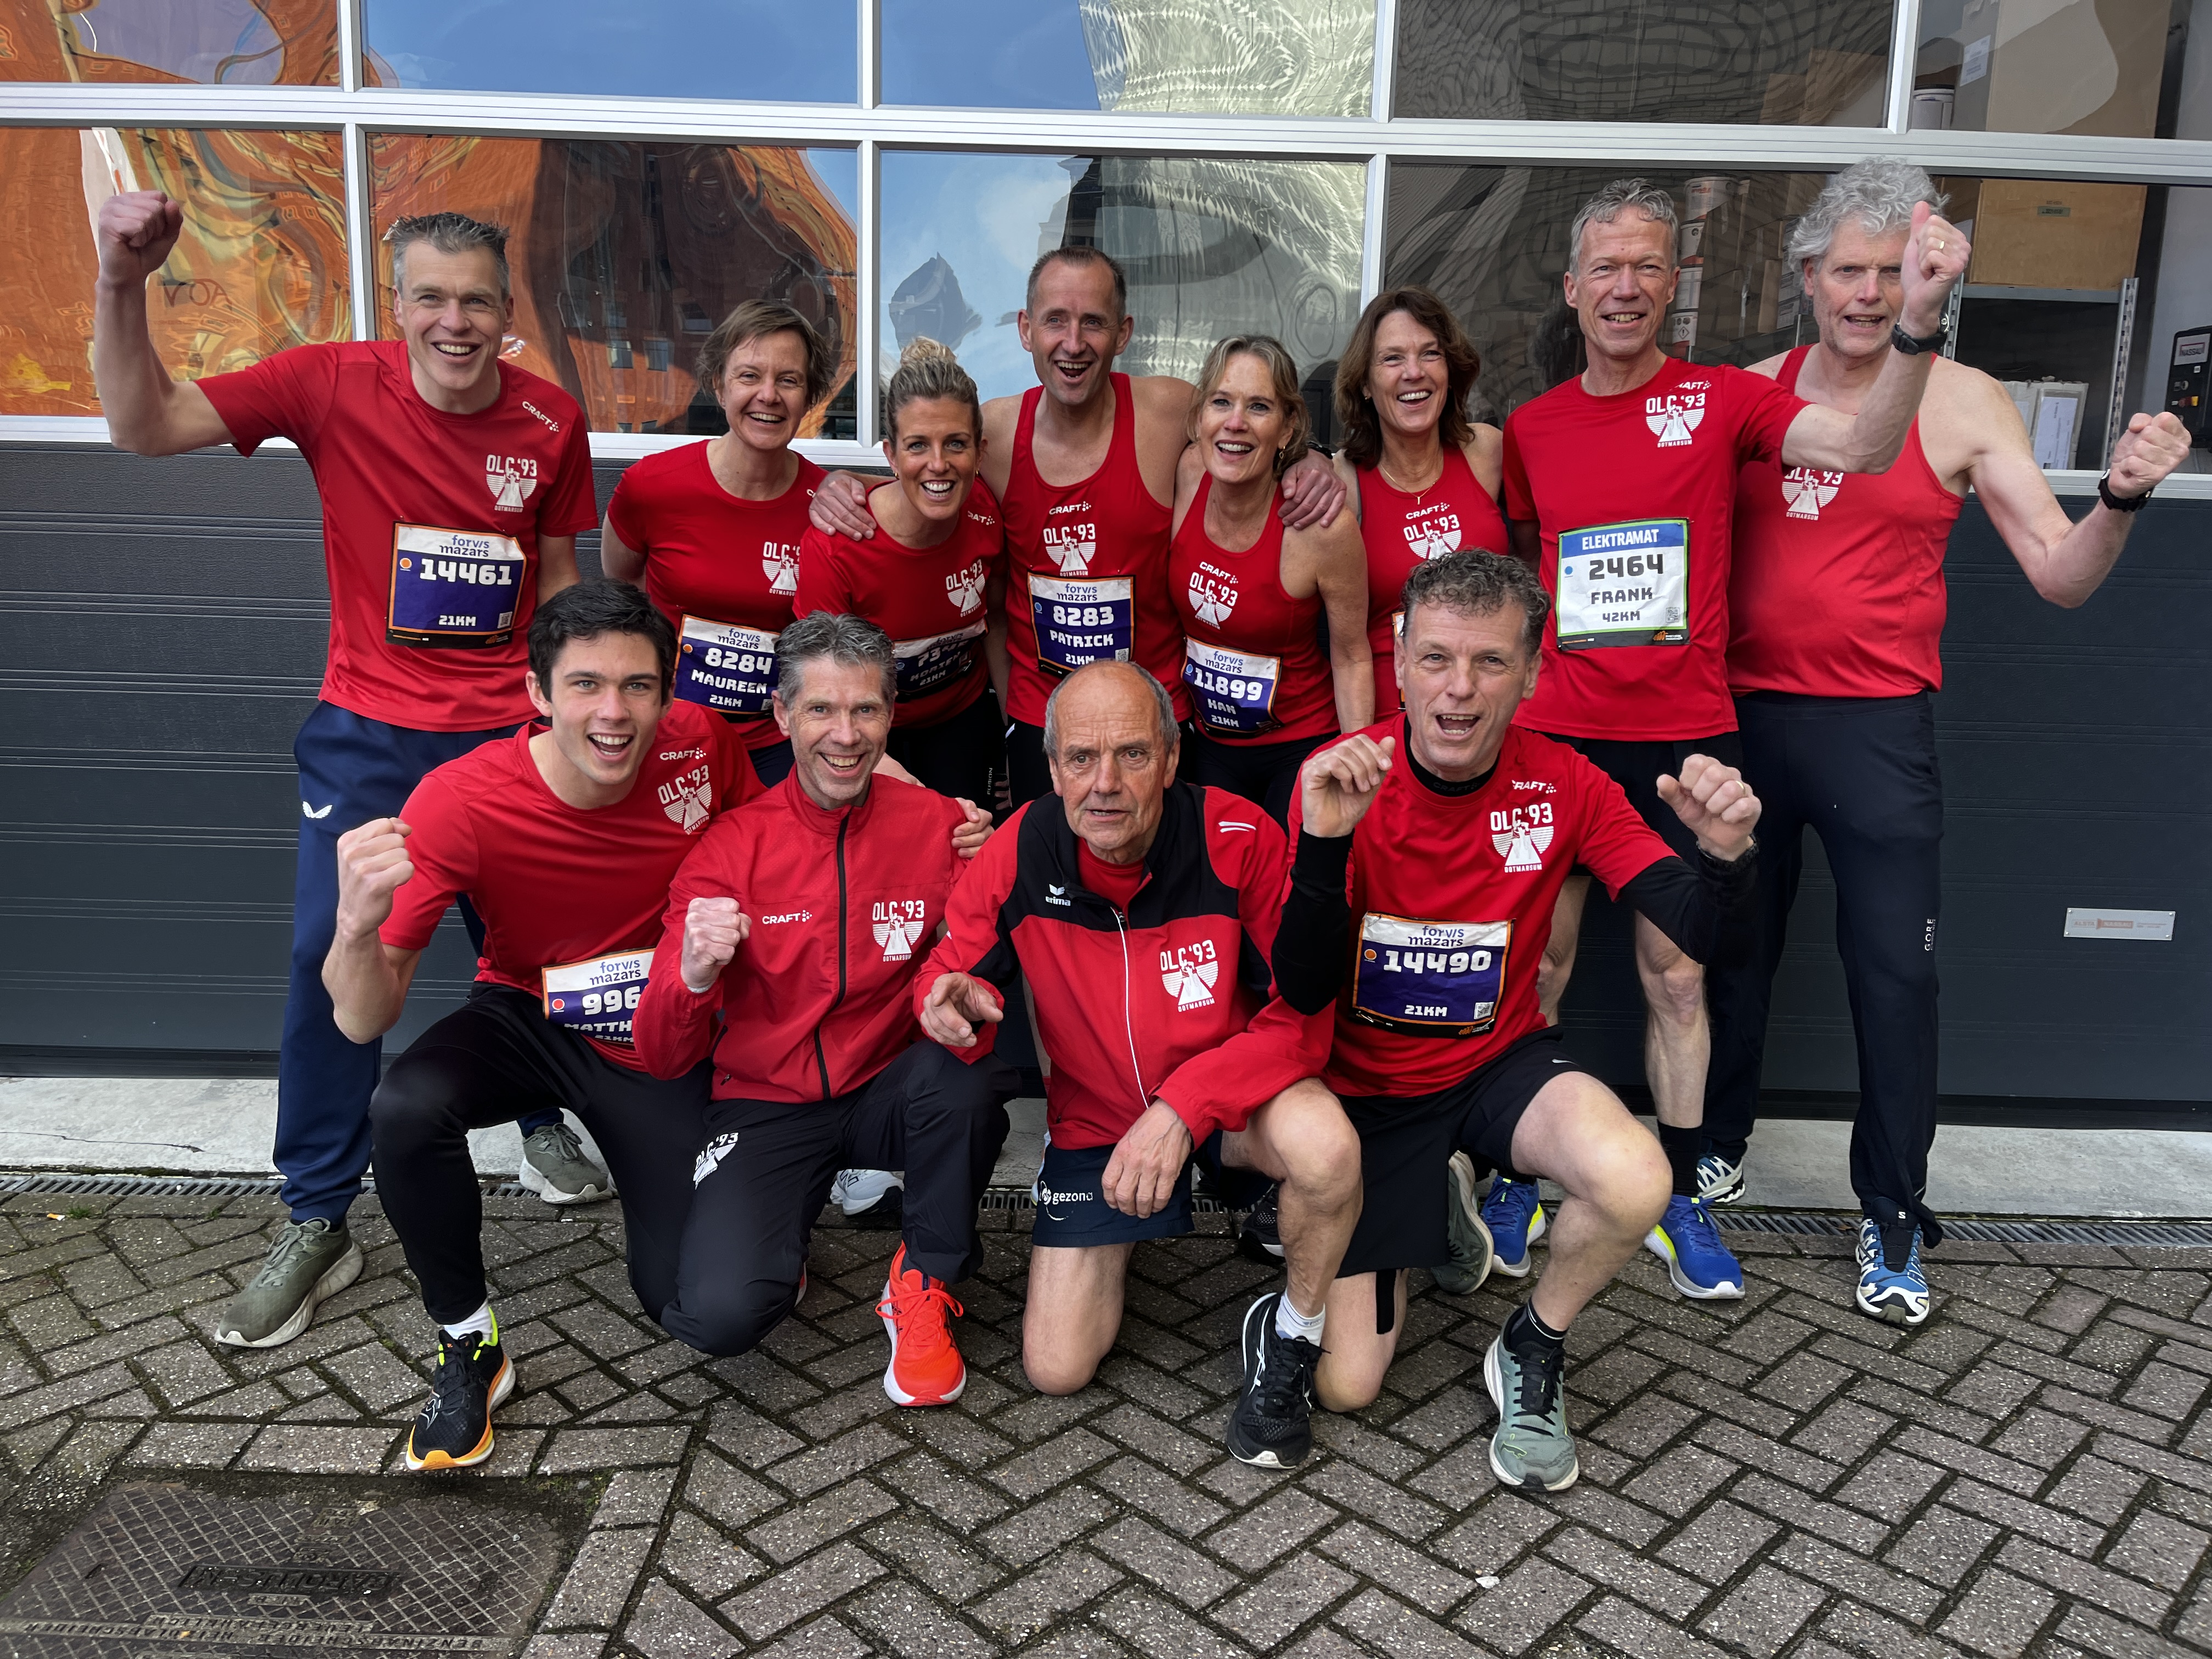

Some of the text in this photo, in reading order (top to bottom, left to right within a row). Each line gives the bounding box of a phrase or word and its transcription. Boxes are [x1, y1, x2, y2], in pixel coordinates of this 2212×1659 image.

[1646, 395, 1677, 414] OLC
[522, 401, 552, 425] CRAFT
[1657, 439, 1692, 448] OOTMARSUM
[486, 454, 515, 475] OLC
[1049, 504, 1081, 515] CRAFT
[1406, 505, 1440, 520] CRAFT
[1786, 512, 1819, 521] OOTMARSUM
[1043, 526, 1070, 544] OLC
[1403, 521, 1431, 541] OLC
[1582, 529, 1659, 550] ELEKTRAMAT
[439, 545, 489, 557] mazars
[763, 541, 800, 562] OLC '9
[420, 558, 512, 585] 14461
[1199, 561, 1231, 580] CRAFT
[1589, 554, 1663, 580] 2464
[946, 569, 968, 590] OLC
[1189, 572, 1216, 595] OLC
[1057, 592, 1097, 601] mazars
[1591, 587, 1653, 604] FRANK
[438, 615, 476, 627] 21KM
[1053, 605, 1114, 627] 8283
[1602, 611, 1640, 622] 42KM
[718, 635, 759, 649] mazars
[1049, 629, 1114, 647] PATRICK
[705, 648, 772, 675] 8284
[1065, 653, 1094, 664] 21KM
[1205, 658, 1242, 673] mazars
[691, 669, 767, 694] MAUREEN
[919, 670, 946, 686] 21KM
[1194, 667, 1263, 701] 11899
[709, 694, 742, 707] 21KM
[1207, 698, 1237, 714] HAN
[1211, 714, 1239, 727] 21KM
[660, 750, 695, 760] CRAFT
[658, 776, 688, 804] OLC
[1434, 782, 1471, 792] CRAFT
[1511, 780, 1547, 791] RAFT
[1490, 808, 1522, 831] OLC
[1504, 864, 1542, 873] OOTMARSUM
[1045, 896, 1071, 906] erima
[761, 912, 801, 924] CRAFT
[872, 901, 898, 922] OLC
[1408, 936, 1463, 947] mazars
[1924, 918, 1933, 951] GORE
[883, 953, 912, 962] OOTMARSUM
[1160, 947, 1187, 971] OLC
[1384, 950, 1492, 974] 14490
[590, 969, 641, 985] mazars
[582, 985, 646, 1015] 996
[1177, 998, 1215, 1012] OOTMARSUM
[1404, 1005, 1447, 1017] 21KM
[564, 1020, 633, 1031] MATTH
[595, 1034, 634, 1042] 21KM
